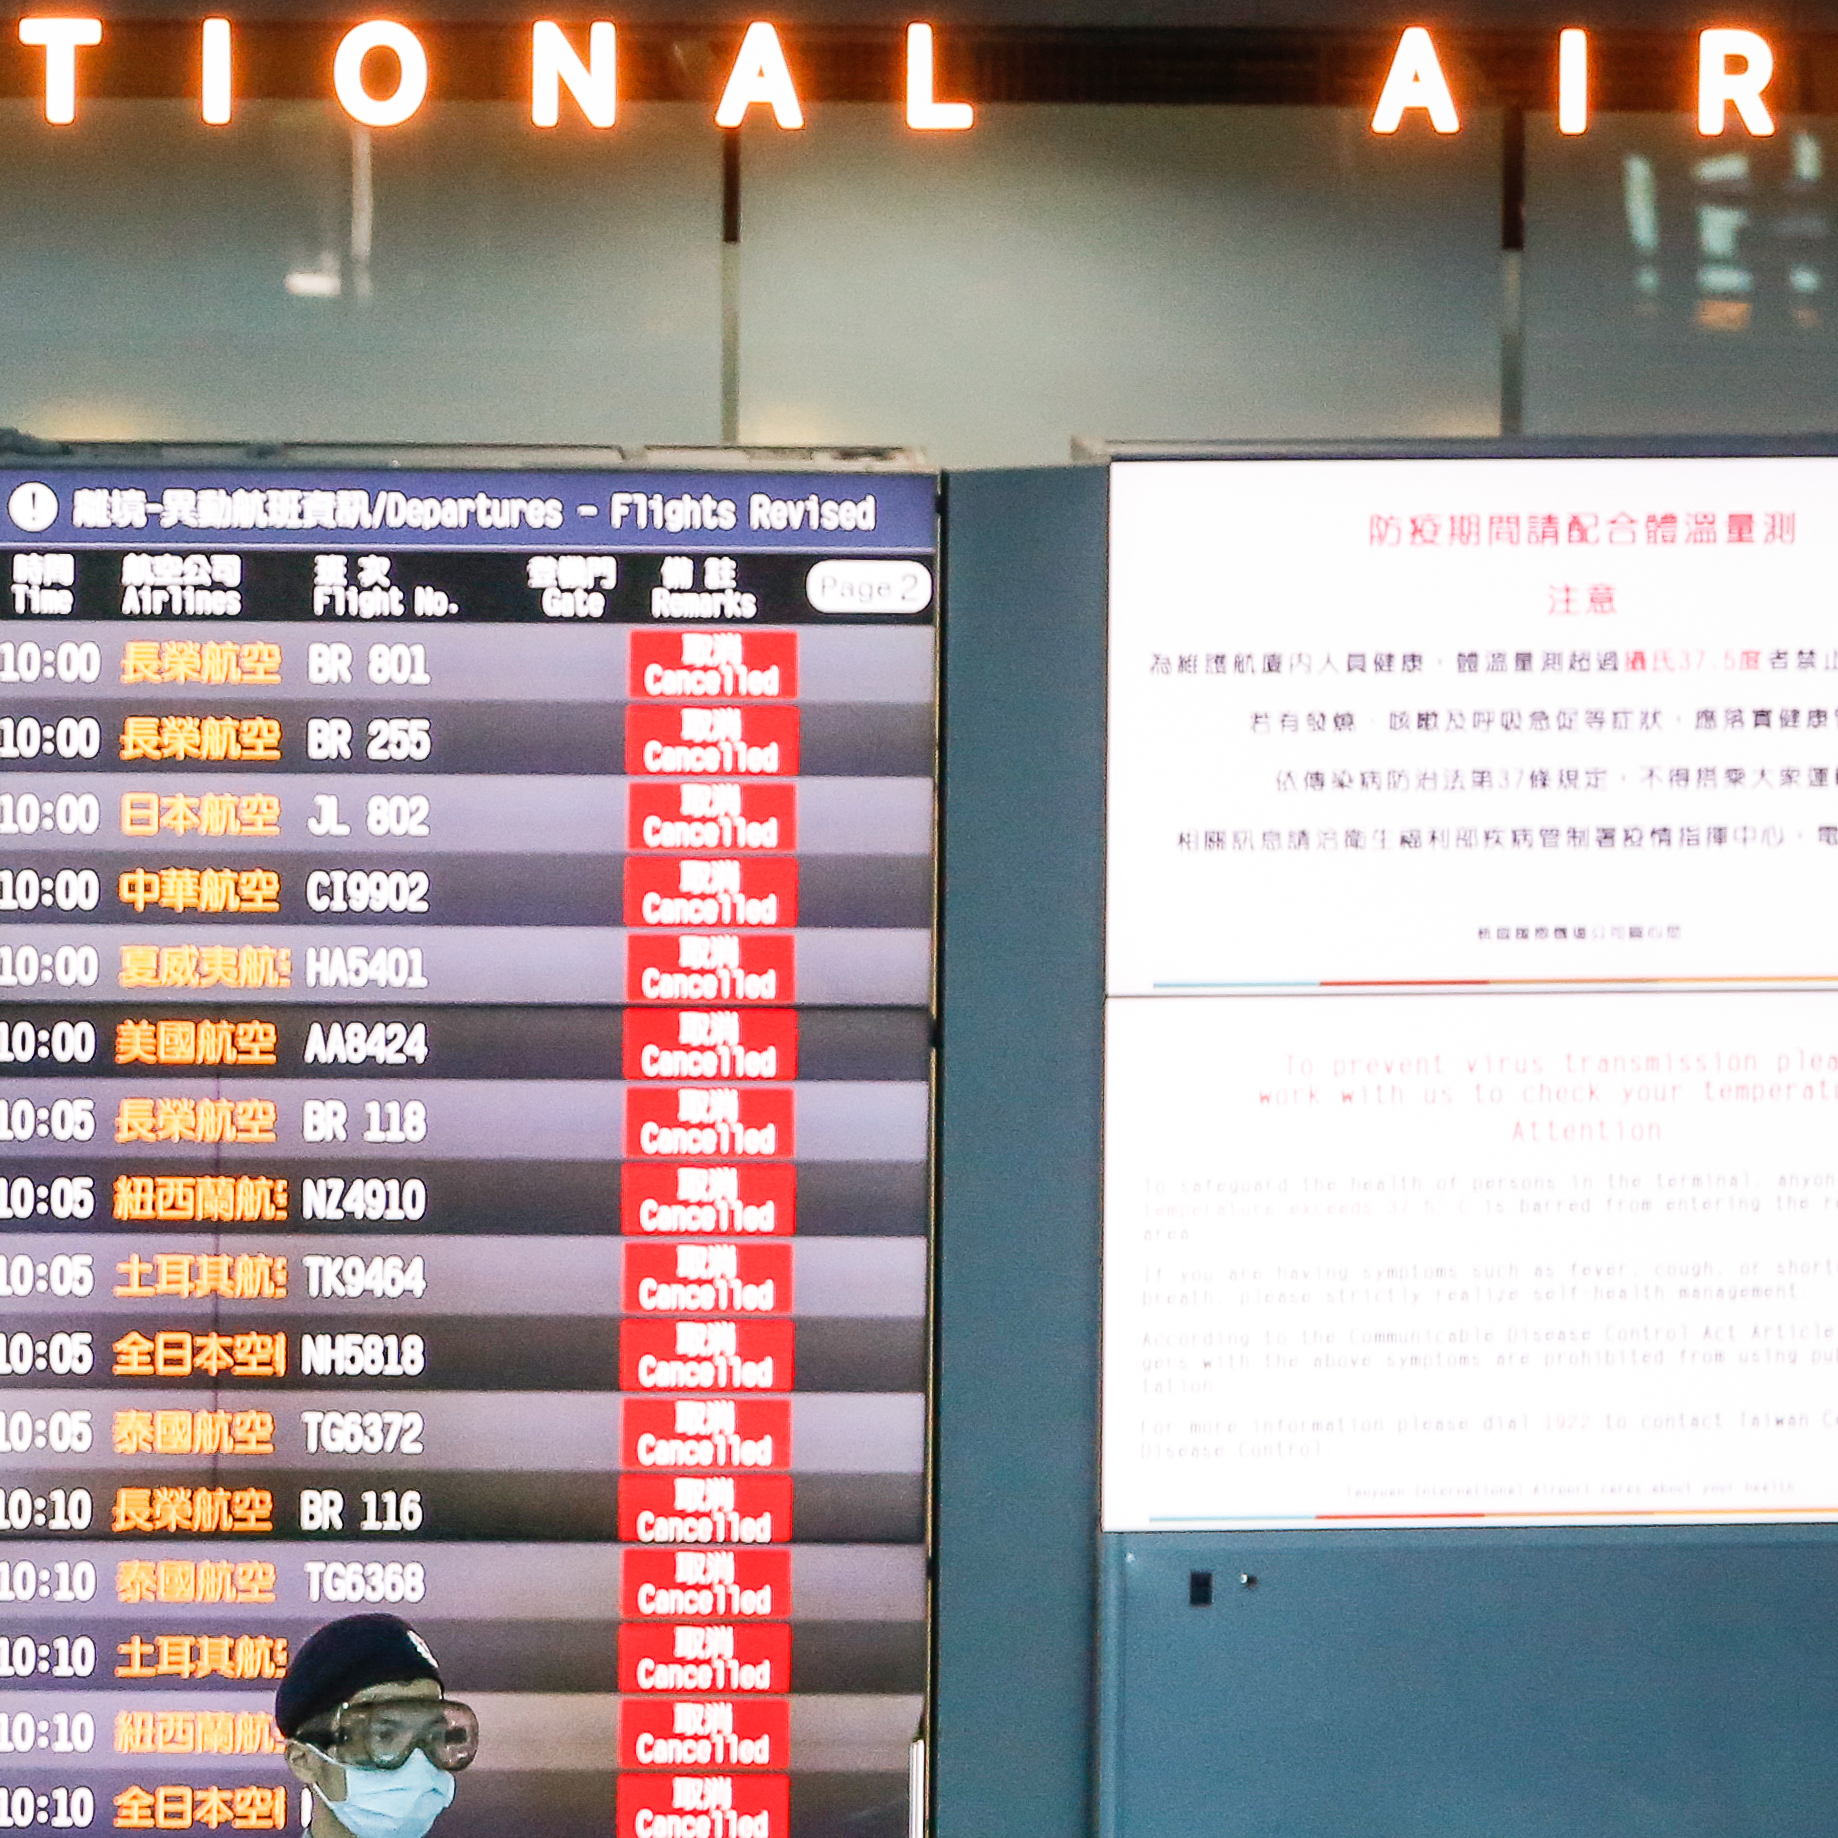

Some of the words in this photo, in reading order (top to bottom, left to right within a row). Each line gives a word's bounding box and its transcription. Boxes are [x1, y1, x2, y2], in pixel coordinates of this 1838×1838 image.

[1367, 23, 1779, 139] AIR
[609, 491, 738, 534] Flights
[748, 492, 877, 532] Revised
[1368, 511, 1797, 547] 防疫期間請配合體溫量測
[9, 583, 75, 616] Time
[120, 584, 243, 617] Airlines
[312, 584, 406, 620] Flight
[412, 584, 461, 618] No.
[540, 586, 607, 619] Gate
[649, 586, 759, 620] Remarks
[1547, 582, 1618, 616] 注意
[121, 640, 283, 685] 長榮航空
[307, 642, 353, 685] BR
[367, 642, 432, 686] 801
[643, 663, 781, 697] Cancelled
[119, 715, 282, 761] 長榮航空
[307, 718, 353, 760] BR
[366, 718, 432, 761] 255
[642, 740, 780, 774] Cancelled
[120, 793, 282, 837] 日本航空
[306, 793, 352, 837] JL
[366, 794, 431, 837] 802
[641, 815, 780, 849] Cancelled
[118, 867, 281, 913] 中華航空
[306, 870, 430, 913] CI9902
[641, 892, 779, 926] Cancelled
[305, 945, 429, 989] HA5401
[640, 967, 778, 1001] Cancelled
[114, 1018, 277, 1065] 美國航空
[303, 1022, 429, 1065] AA8424
[640, 1044, 778, 1078] Cancelled
[114, 1097, 278, 1144] 長榮航空
[302, 1099, 348, 1143] BR
[362, 1099, 427, 1143] 118
[639, 1121, 778, 1156] Cancelled
[301, 1177, 427, 1221] NZ4910
[638, 1199, 777, 1233] Cancelled
[301, 1255, 427, 1299] TK9464
[637, 1277, 776, 1312] Cancelled
[300, 1333, 425, 1376] NH5818
[637, 1354, 775, 1389] Cancelled
[112, 1408, 275, 1456] 泰國航空
[300, 1410, 424, 1455] TG6372
[636, 1433, 774, 1467] Cancelled
[111, 1486, 273, 1533] 長榮航空
[300, 1489, 344, 1531] BR
[361, 1490, 423, 1531] 116
[635, 1510, 773, 1544] Cancelled
[115, 1559, 277, 1604] 泰國航空
[303, 1560, 426, 1603] TG6368
[636, 1583, 773, 1616] Cancelled
[635, 1658, 772, 1690] Cancelled
[634, 1733, 771, 1765] Cancelled
